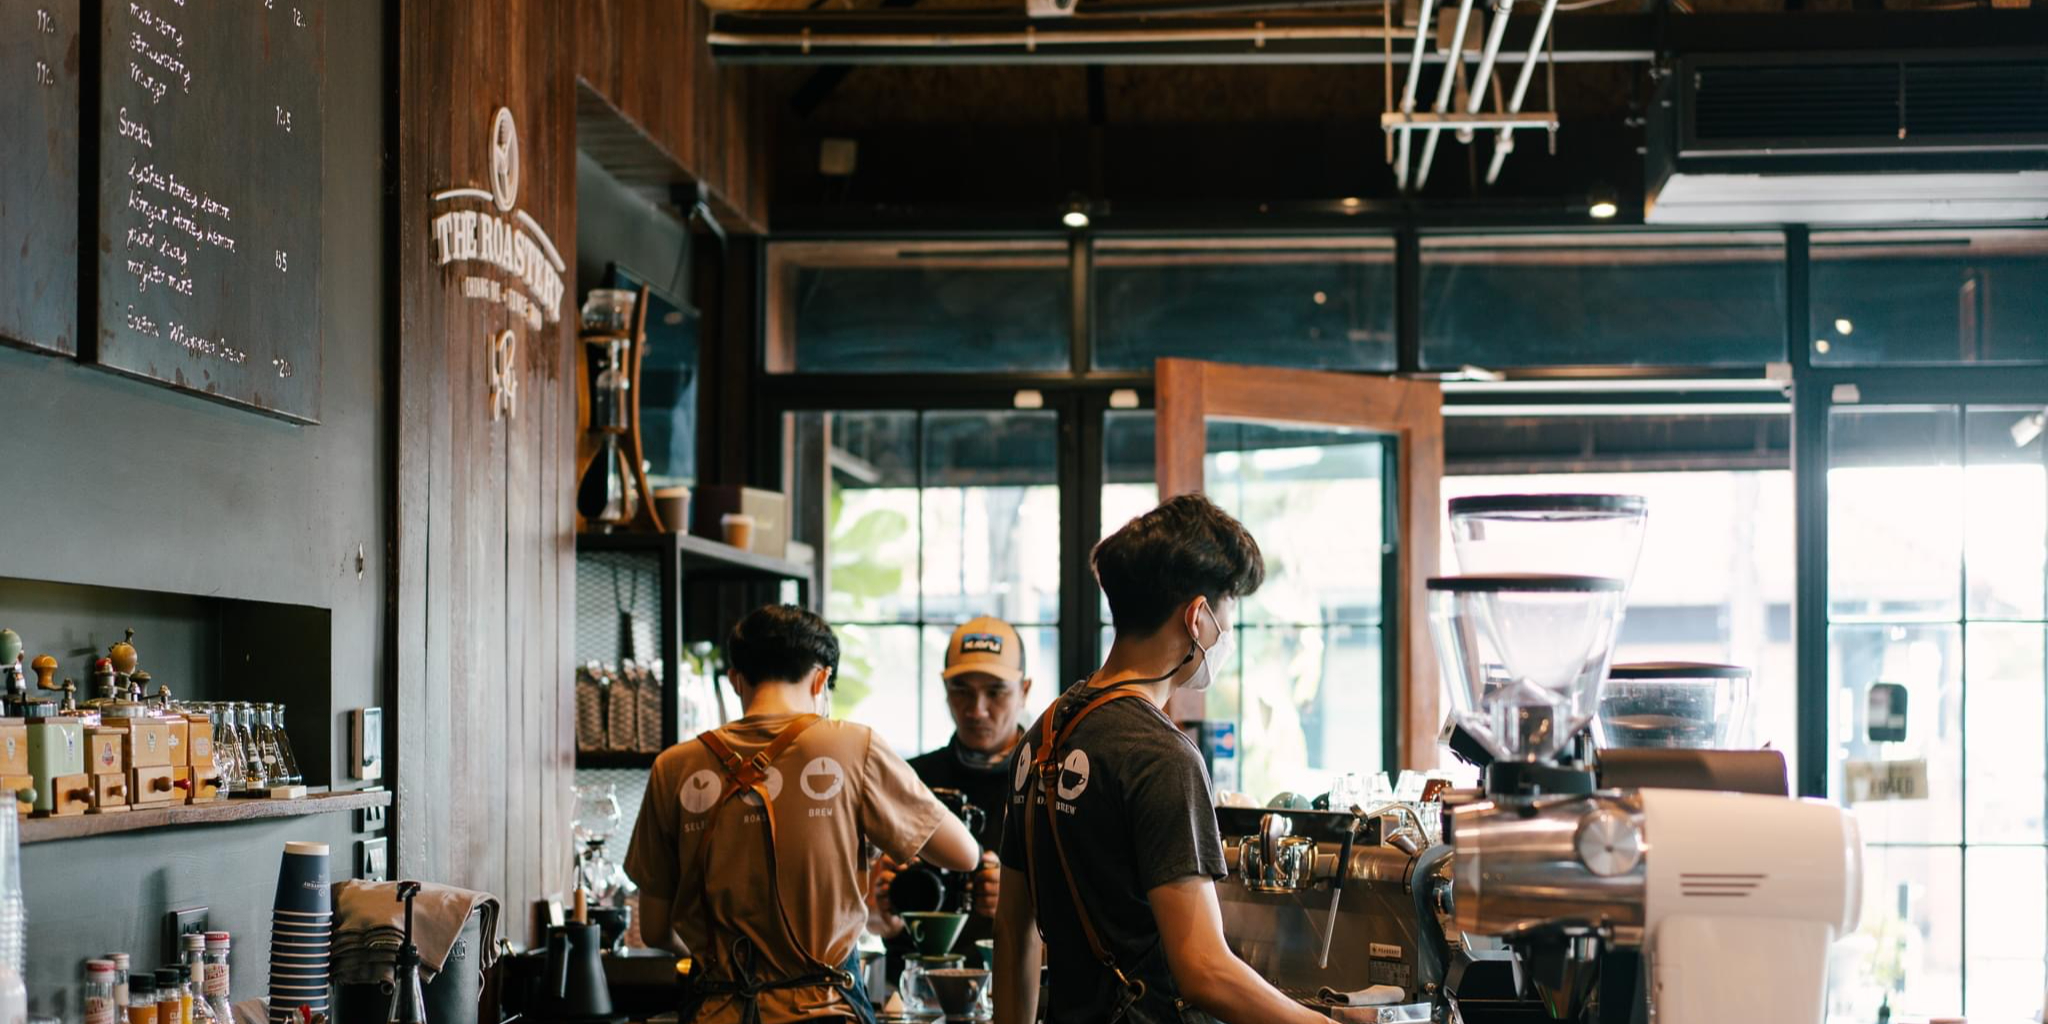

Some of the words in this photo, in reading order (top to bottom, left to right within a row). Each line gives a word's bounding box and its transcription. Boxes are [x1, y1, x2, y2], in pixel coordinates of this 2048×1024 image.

[118, 107, 152, 148] Soda
[437, 209, 477, 265] THE
[480, 211, 565, 323] ROASTERY
[808, 808, 833, 818] BREW
[1056, 801, 1077, 815] BREW
